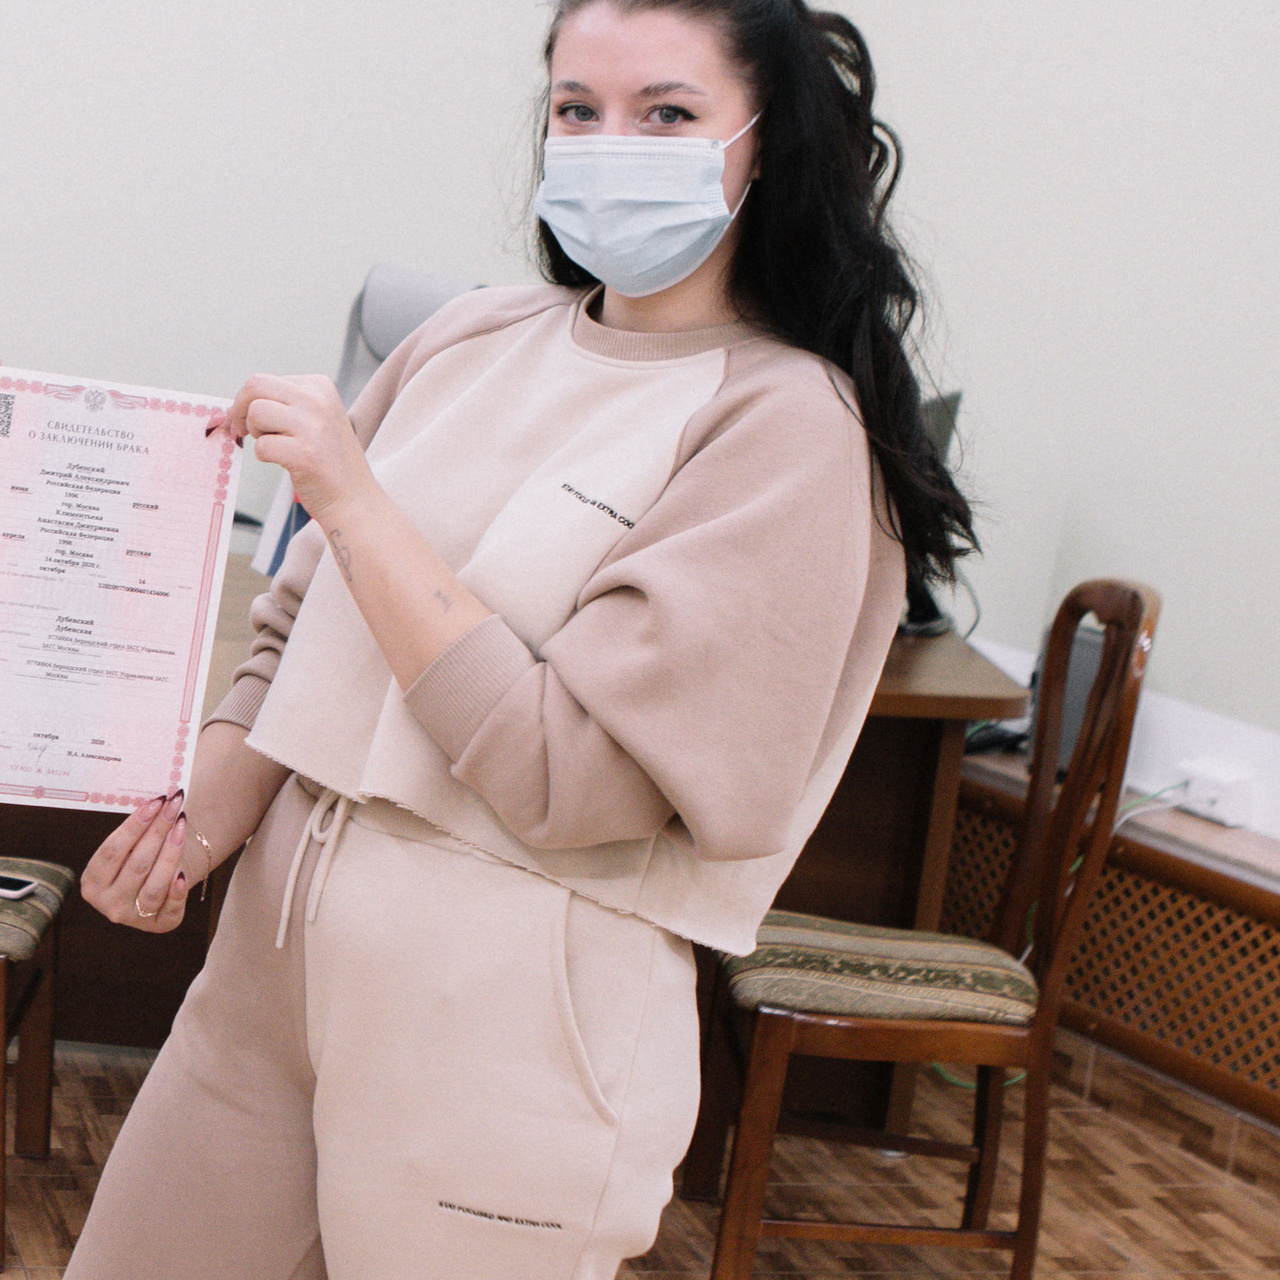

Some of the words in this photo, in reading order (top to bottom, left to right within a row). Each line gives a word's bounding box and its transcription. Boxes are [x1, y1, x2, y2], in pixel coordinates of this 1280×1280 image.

[46, 420, 134, 440] СВИДЕТЕЛЬСТВО
[28, 430, 36, 438] О
[39, 432, 113, 449] ЗАКЛЮЧЕНИИ
[116, 443, 149, 454] БРАКА
[39, 468, 72, 478] Дмитрий
[73, 473, 129, 486] Александрович
[46, 479, 83, 489] Российская
[84, 484, 120, 495] Федерация
[40, 526, 76, 536] Российская
[78, 532, 113, 542] Федерация
[69, 550, 93, 558] Москва
